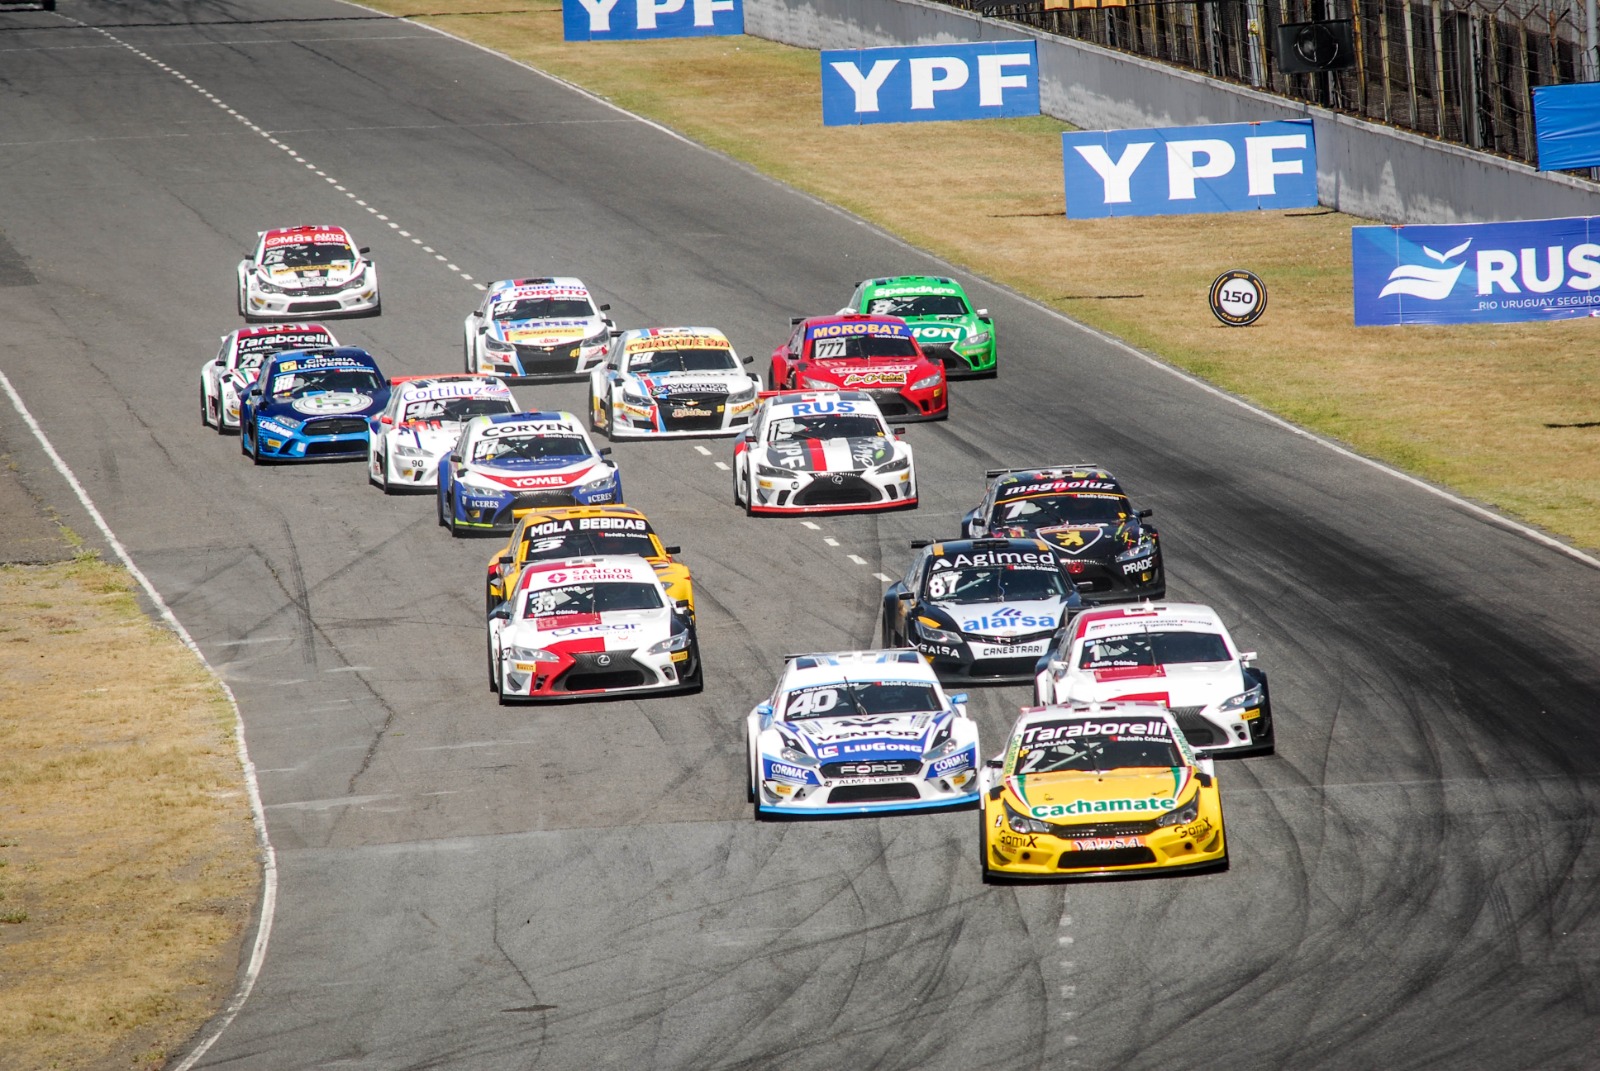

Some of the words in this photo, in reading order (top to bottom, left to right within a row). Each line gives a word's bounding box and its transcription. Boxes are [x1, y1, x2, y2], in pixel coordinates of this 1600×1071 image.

[577, 0, 734, 32] YPF
[830, 53, 1031, 112] YPF
[1073, 134, 1307, 204] YPF
[1476, 243, 1600, 295] RUS
[874, 286, 956, 296] SpeedAgro
[1222, 290, 1254, 304] 150
[1478, 301, 1498, 310] RIO
[1501, 298, 1554, 309] URUGUAY
[813, 324, 902, 338] MOROBAT
[909, 327, 962, 340] ION
[238, 334, 328, 349] Taraborelli
[818, 342, 844, 356] 777
[239, 354, 264, 368] 23
[404, 385, 482, 401] Cortiluz
[406, 401, 446, 415] 90
[792, 401, 856, 416] RUS
[482, 423, 574, 436] CORVEN
[512, 477, 567, 487] YOMEL
[1004, 480, 1116, 496] magnoluz
[1005, 500, 1026, 519] 7
[531, 520, 573, 537] MOLA
[579, 518, 646, 530] BEBIDAS
[531, 540, 564, 553] 3
[954, 551, 1055, 568] Agimed
[1123, 556, 1153, 575] PRADE
[929, 574, 960, 597] 87
[531, 596, 556, 614] 33
[964, 615, 1055, 632] alarsa
[983, 646, 1042, 656] CANESTRARI
[1089, 645, 1100, 661] 1
[787, 690, 838, 716] 40
[817, 730, 919, 741] VENTOR
[1024, 721, 1167, 744] Taraborelli
[1035, 739, 1076, 748] PALMA
[841, 763, 903, 774] FORD
[934, 753, 969, 771] CORMAC
[1020, 750, 1047, 774] 2
[771, 763, 809, 780] CORMAC
[1032, 798, 1175, 818] Cachamate
